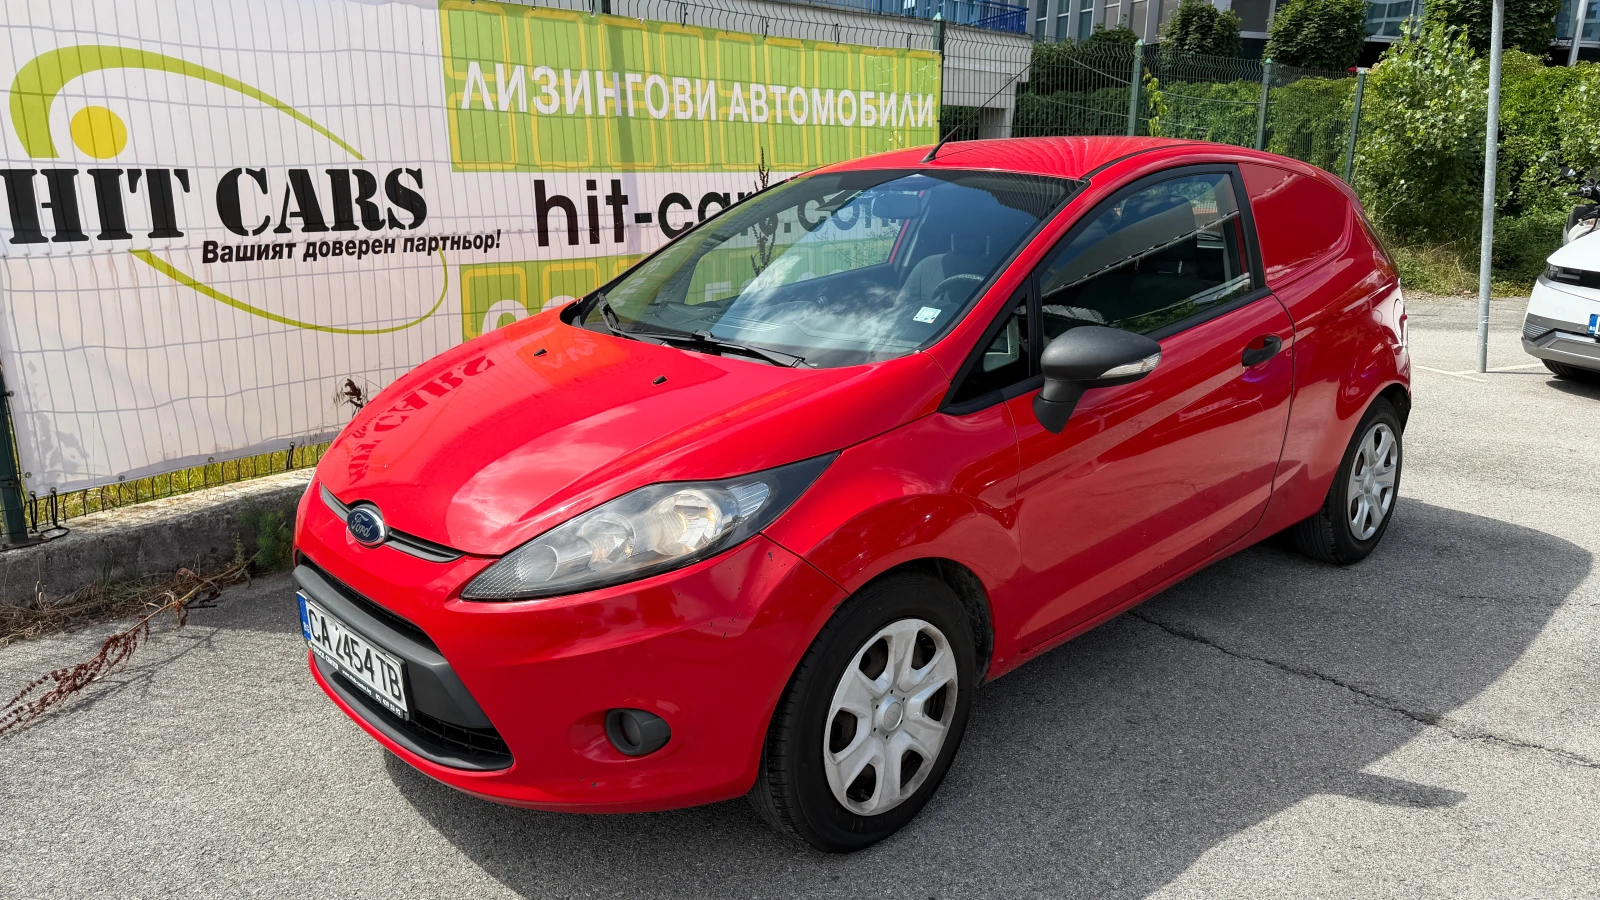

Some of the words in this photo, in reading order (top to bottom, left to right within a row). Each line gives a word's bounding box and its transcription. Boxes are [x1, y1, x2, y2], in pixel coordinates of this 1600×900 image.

[462, 61, 717, 120] ЛИЗИНГОВИ
[728, 82, 934, 128] АВТОМОБИЛИ
[0, 168, 190, 244] HIT
[215, 167, 428, 237] CARS
[202, 239, 297, 264] Вашият
[302, 237, 396, 262] доверен
[402, 229, 502, 257] партньор!
[351, 512, 373, 538] Ford
[308, 608, 333, 653] CA
[335, 621, 376, 684] 2454
[375, 652, 402, 702] TB
